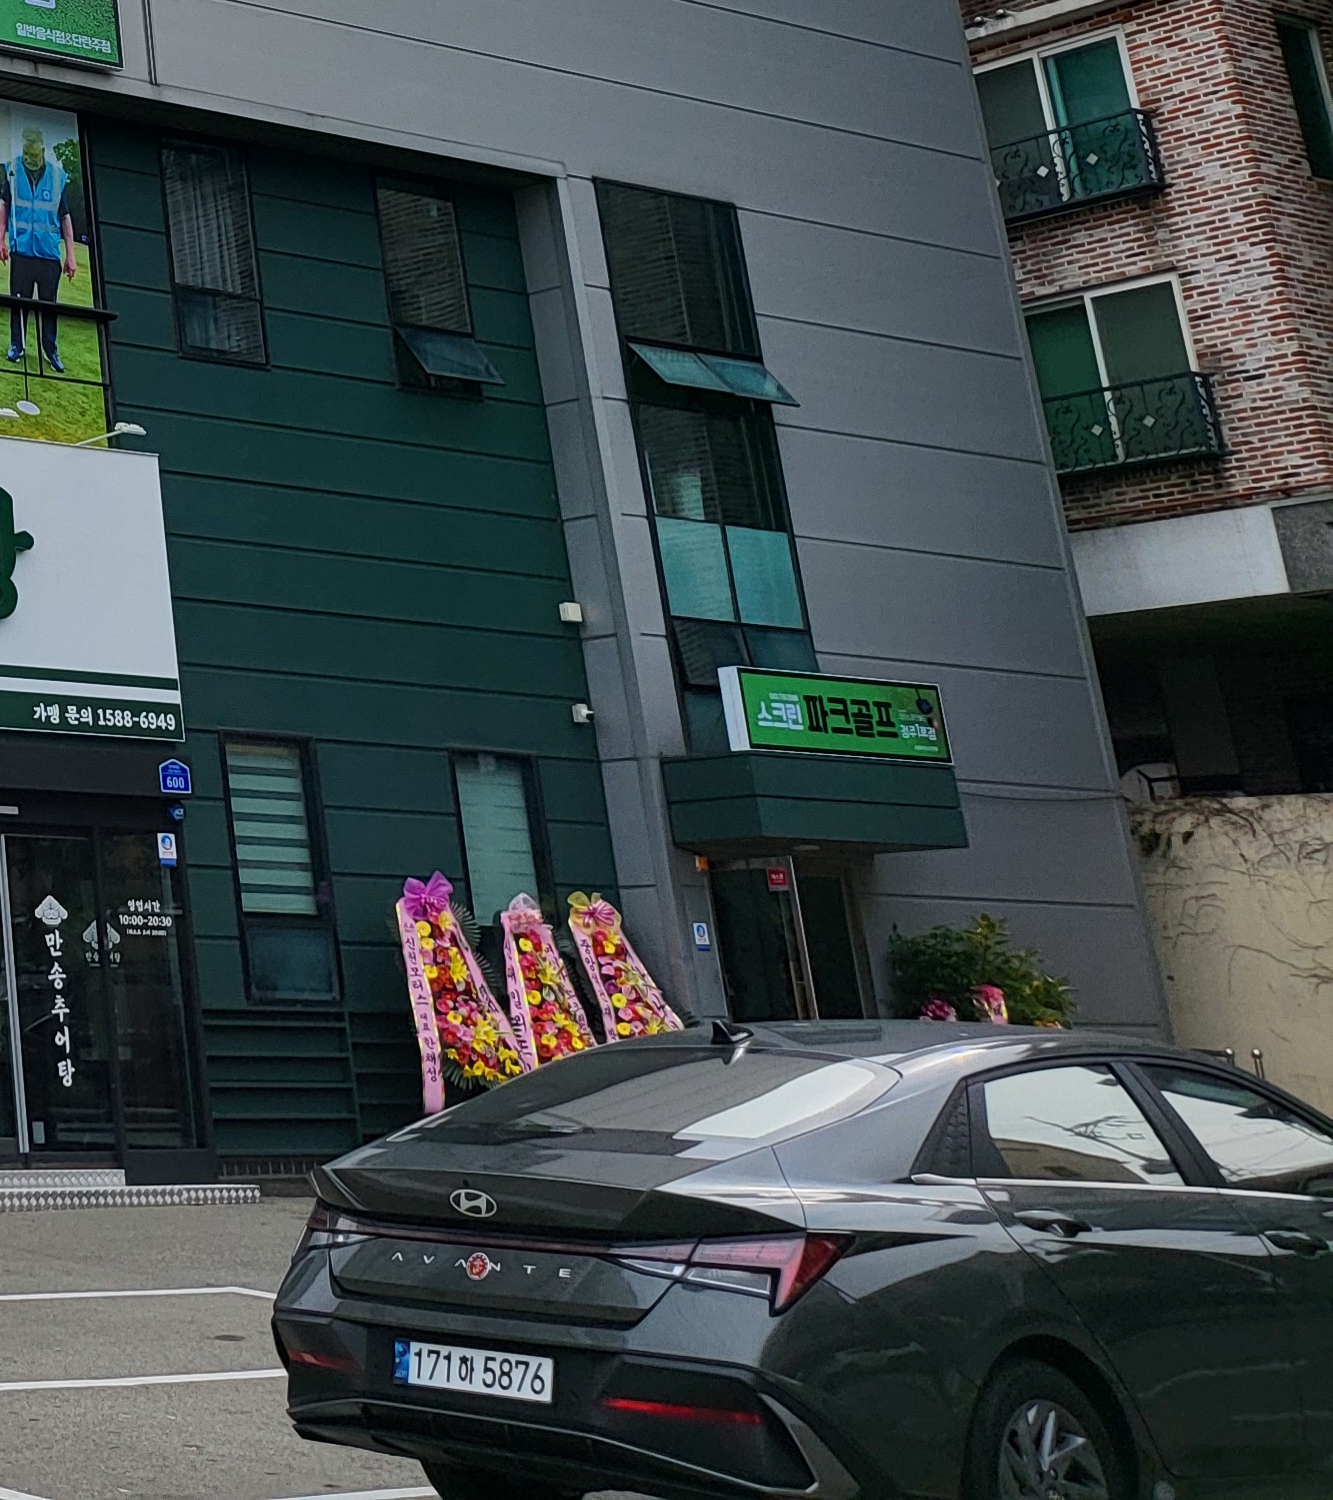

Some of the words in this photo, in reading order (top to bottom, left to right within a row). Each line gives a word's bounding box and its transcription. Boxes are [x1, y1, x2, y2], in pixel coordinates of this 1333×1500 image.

[33, 702, 61, 725] 가맹
[64, 705, 94, 727] 문의
[97, 708, 176, 731] 1588-6949
[757, 700, 805, 730] 스크린
[802, 694, 899, 739] 파크골프
[899, 723, 938, 741] 청주1호점
[166, 776, 185, 789] 600
[127, 899, 161, 913] 영업시간
[118, 914, 173, 927] 10:00-20:30
[44, 929, 76, 1088] 만송추어탕
[413, 1348, 475, 1385] 171하
[482, 1356, 546, 1395] 5876
